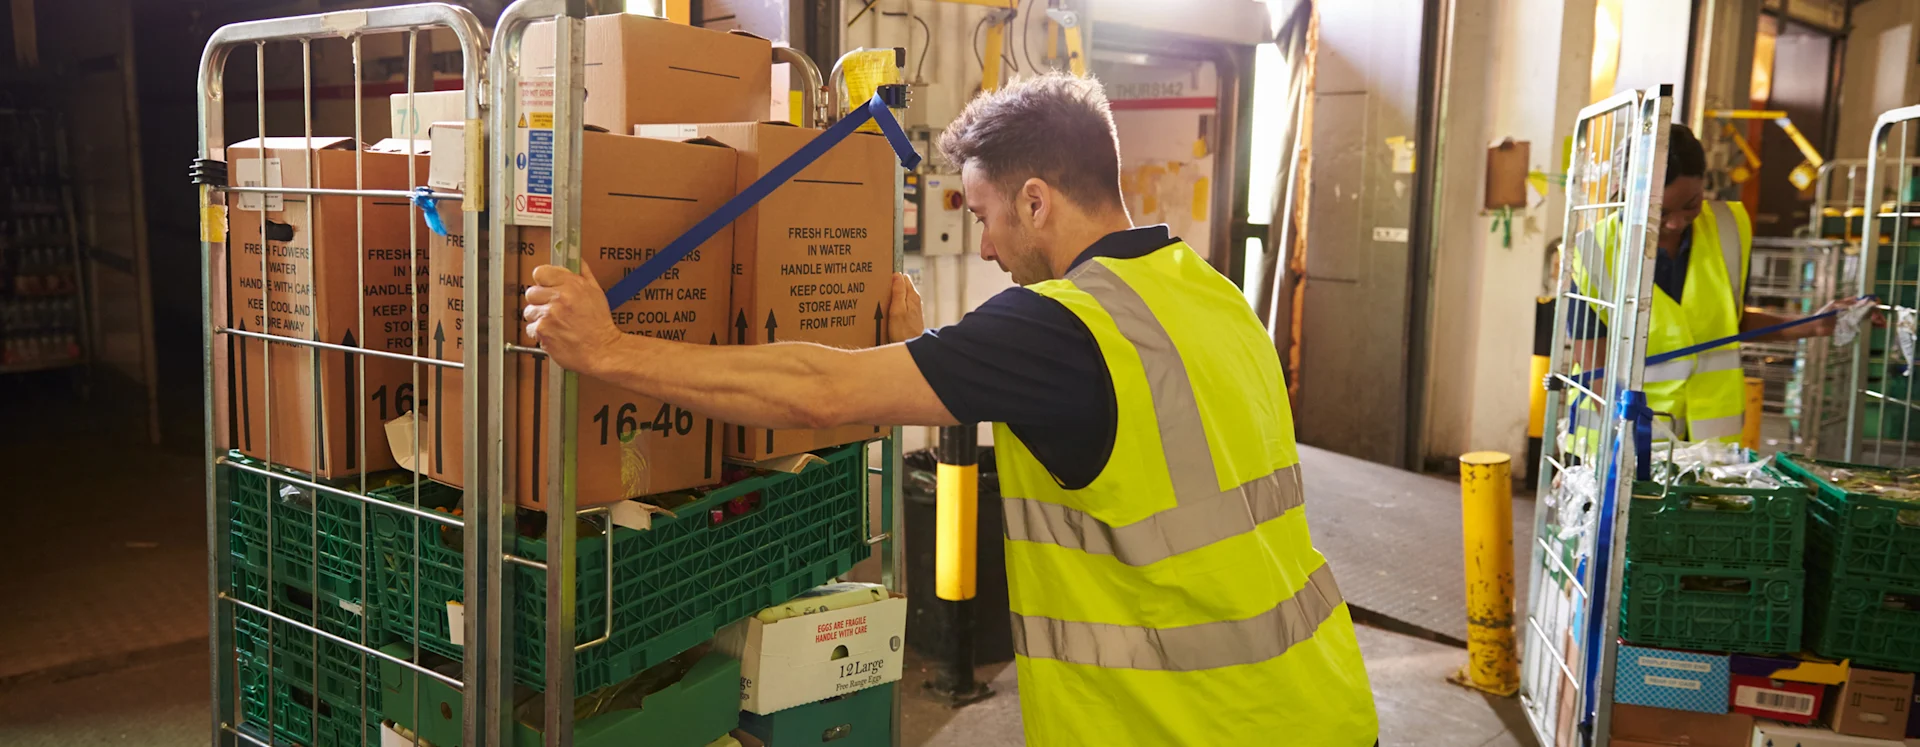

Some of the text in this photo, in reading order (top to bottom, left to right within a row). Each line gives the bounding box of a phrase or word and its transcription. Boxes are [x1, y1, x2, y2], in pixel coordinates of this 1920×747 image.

[788, 227, 868, 239] FRESH FLOWERS
[446, 234, 464, 248] FRE
[272, 245, 310, 260] FLOWERS
[368, 249, 411, 260] FRESH
[600, 247, 642, 260] FRESH
[808, 244, 852, 256] IN WATER
[270, 262, 296, 275] WATER
[394, 265, 406, 277] IN
[780, 262, 873, 276] HANDLE WITH CARE
[240, 277, 272, 290] HANDE
[274, 281, 294, 293] WITH
[790, 282, 866, 296] KEEP COOL AND
[644, 288, 674, 301] WITH
[676, 288, 707, 300] CARE
[248, 298, 310, 316] KEE COOL AND
[372, 304, 407, 317] KEEP
[798, 298, 858, 314] STORE AWAY
[611, 310, 697, 325] EEP COOL AND
[800, 315, 856, 330] FROM FRUIT
[284, 319, 305, 332] AWAY
[592, 402, 694, 446] 16-46
[818, 616, 867, 633] EGGS ARE FRAGILE
[816, 624, 868, 643] HANDLE WITH CARE
[840, 659, 884, 679] 12 Large
[836, 674, 882, 692] Free Range Eggs
